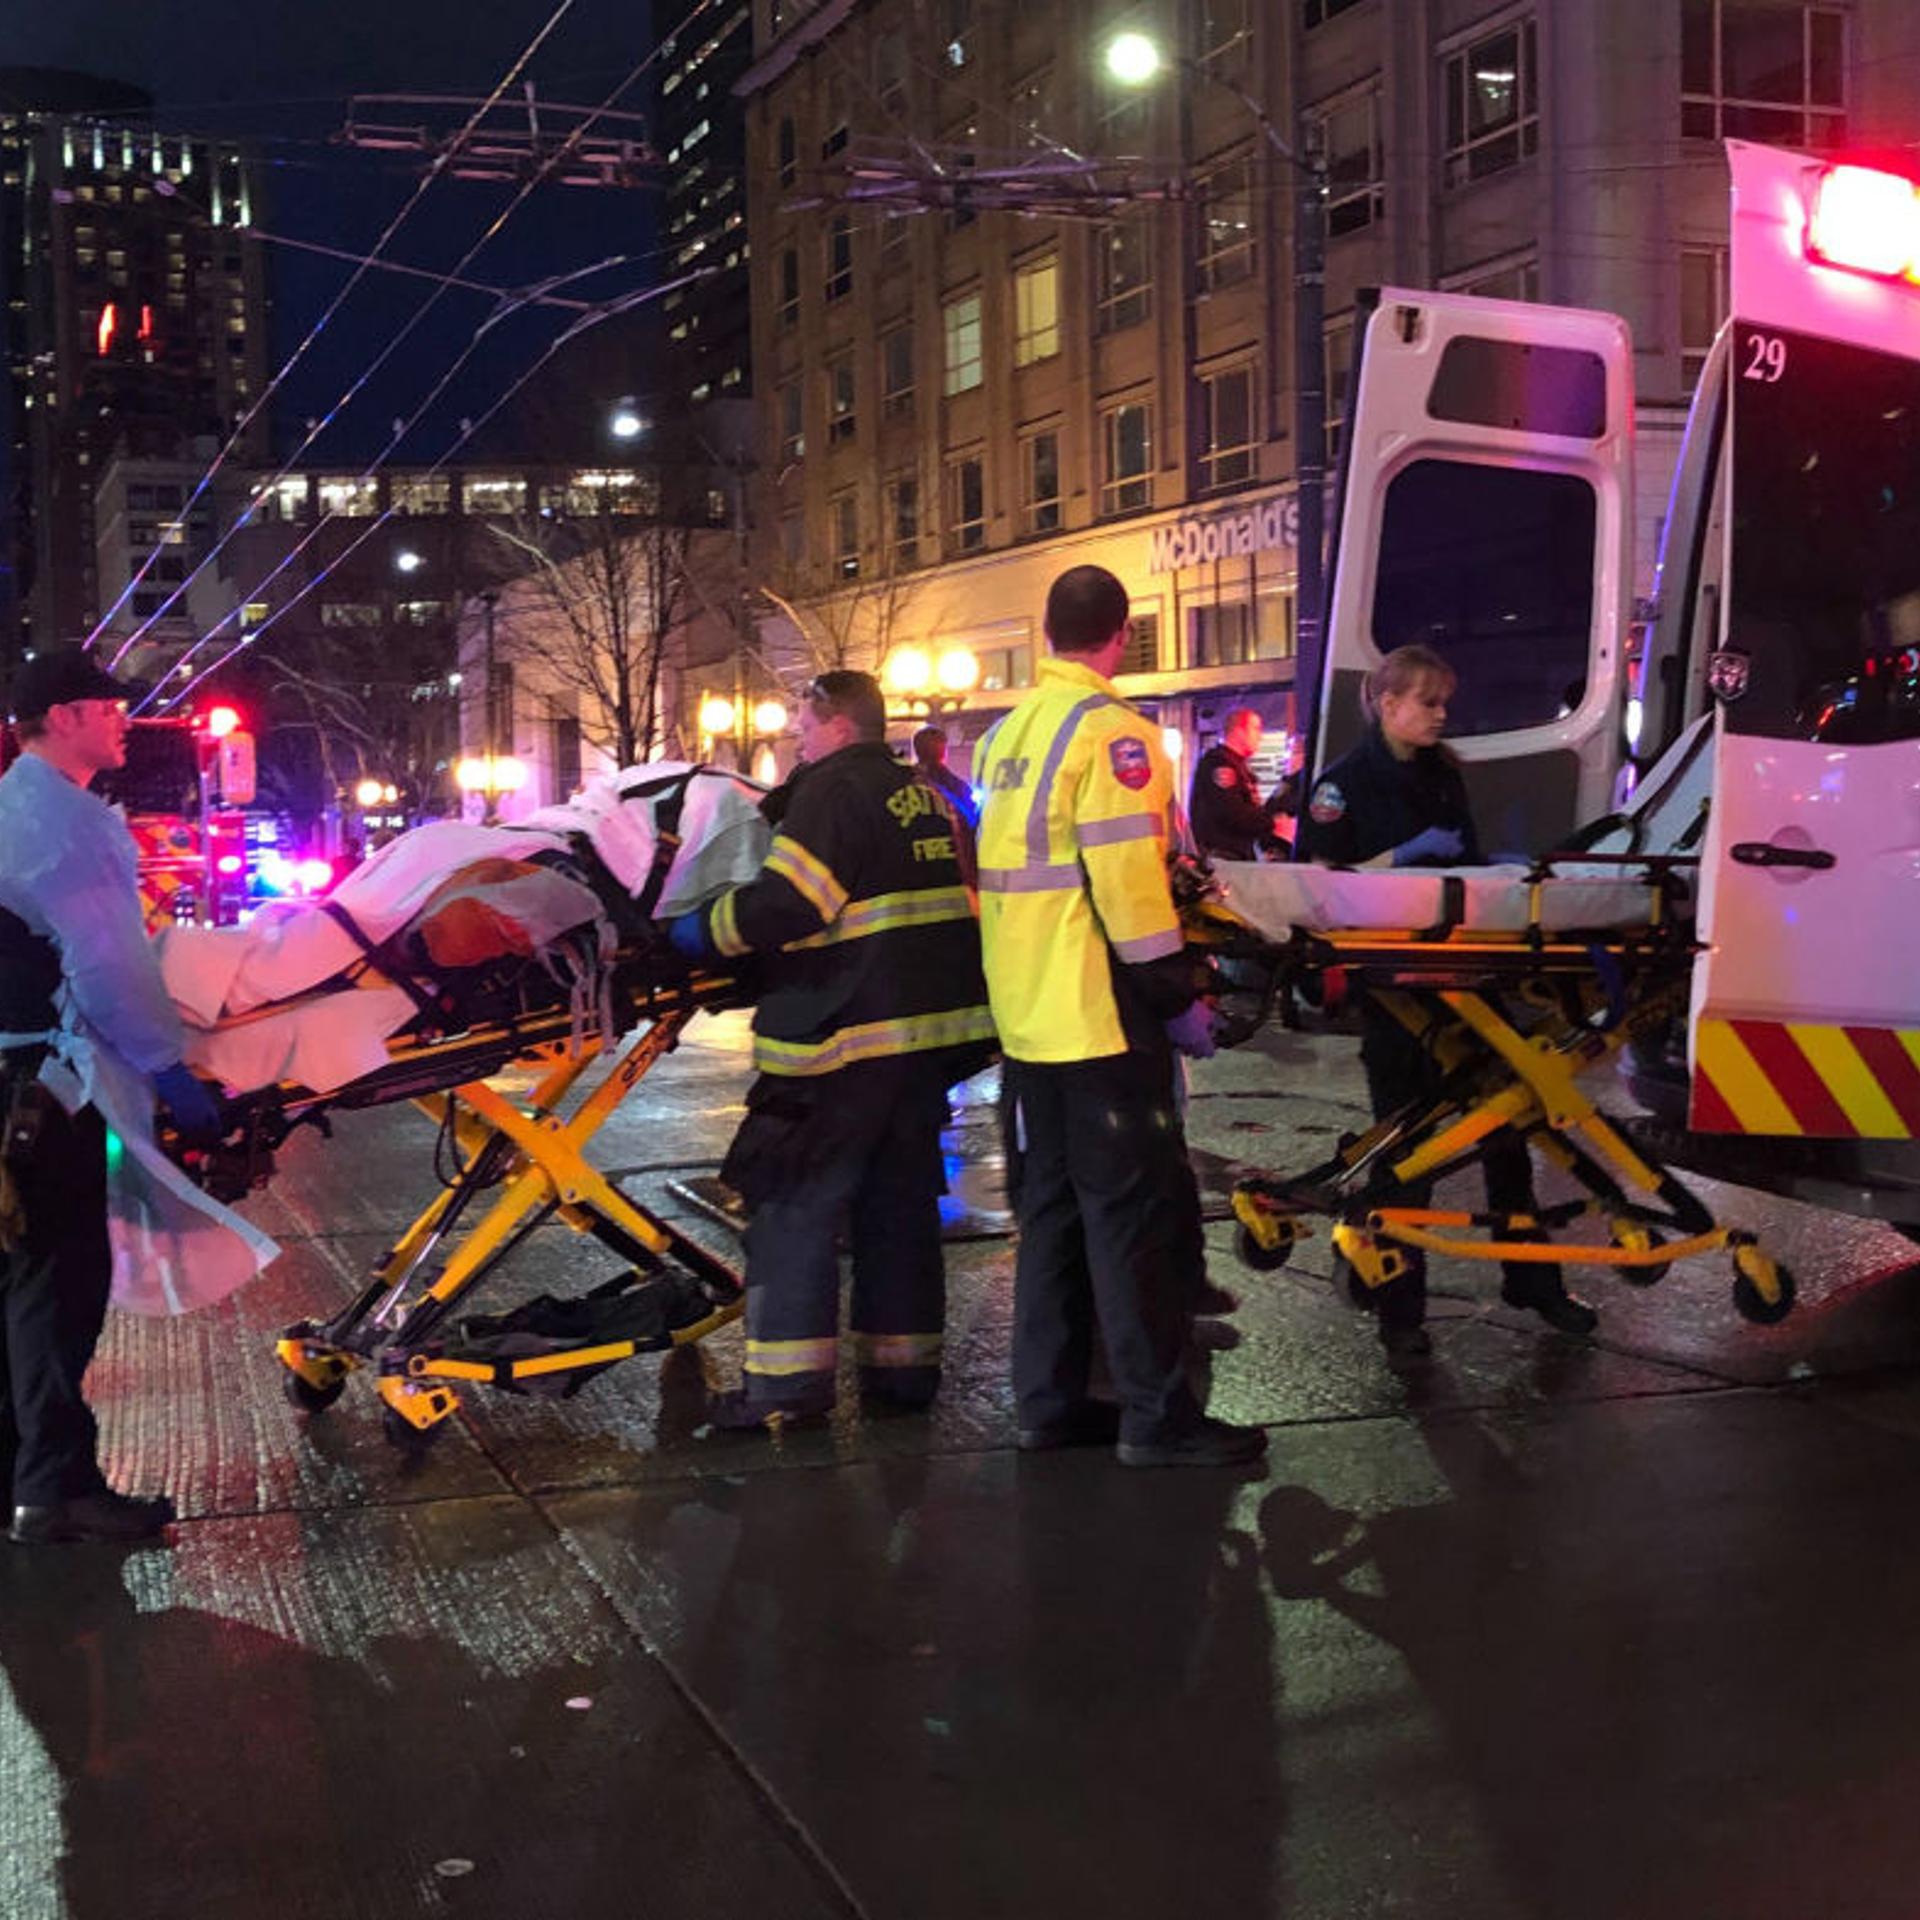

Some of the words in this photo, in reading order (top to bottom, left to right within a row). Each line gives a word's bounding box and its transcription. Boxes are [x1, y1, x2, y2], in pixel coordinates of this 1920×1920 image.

[1743, 334, 1787, 382] 29
[1150, 497, 1299, 574] McDonald's
[913, 836, 956, 862] FIRE
